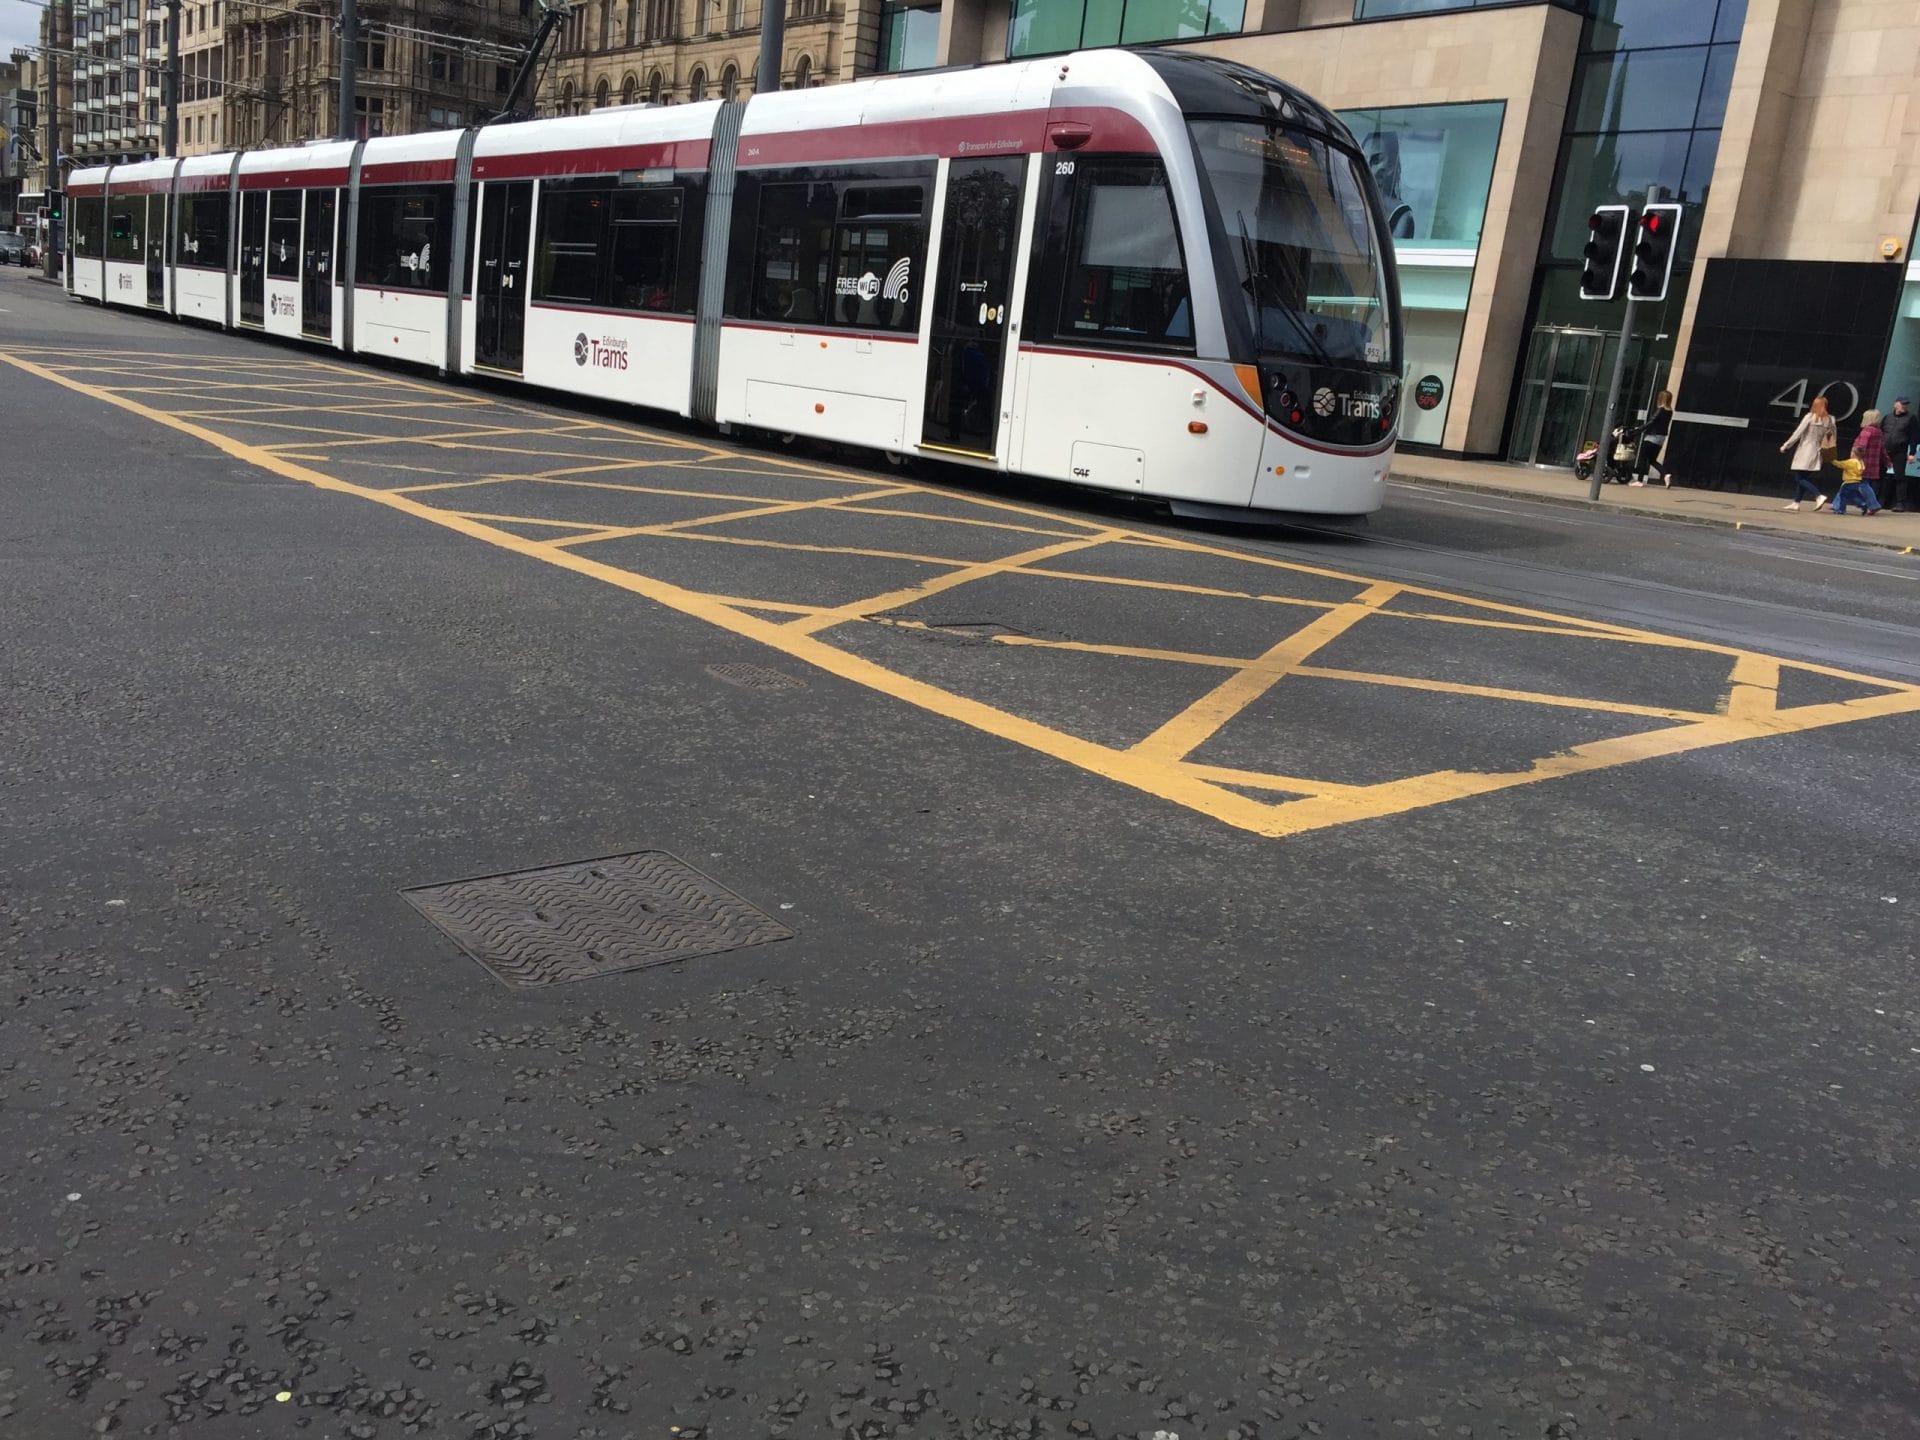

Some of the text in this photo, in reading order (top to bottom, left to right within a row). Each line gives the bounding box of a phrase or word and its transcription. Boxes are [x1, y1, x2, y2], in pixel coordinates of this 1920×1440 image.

[1055, 161, 1075, 175] 260
[836, 277, 858, 289] FREE
[602, 335, 628, 350] Edinburgh
[591, 339, 628, 370] Trams
[1338, 393, 1380, 419] Trams
[1768, 378, 1859, 422] 40
